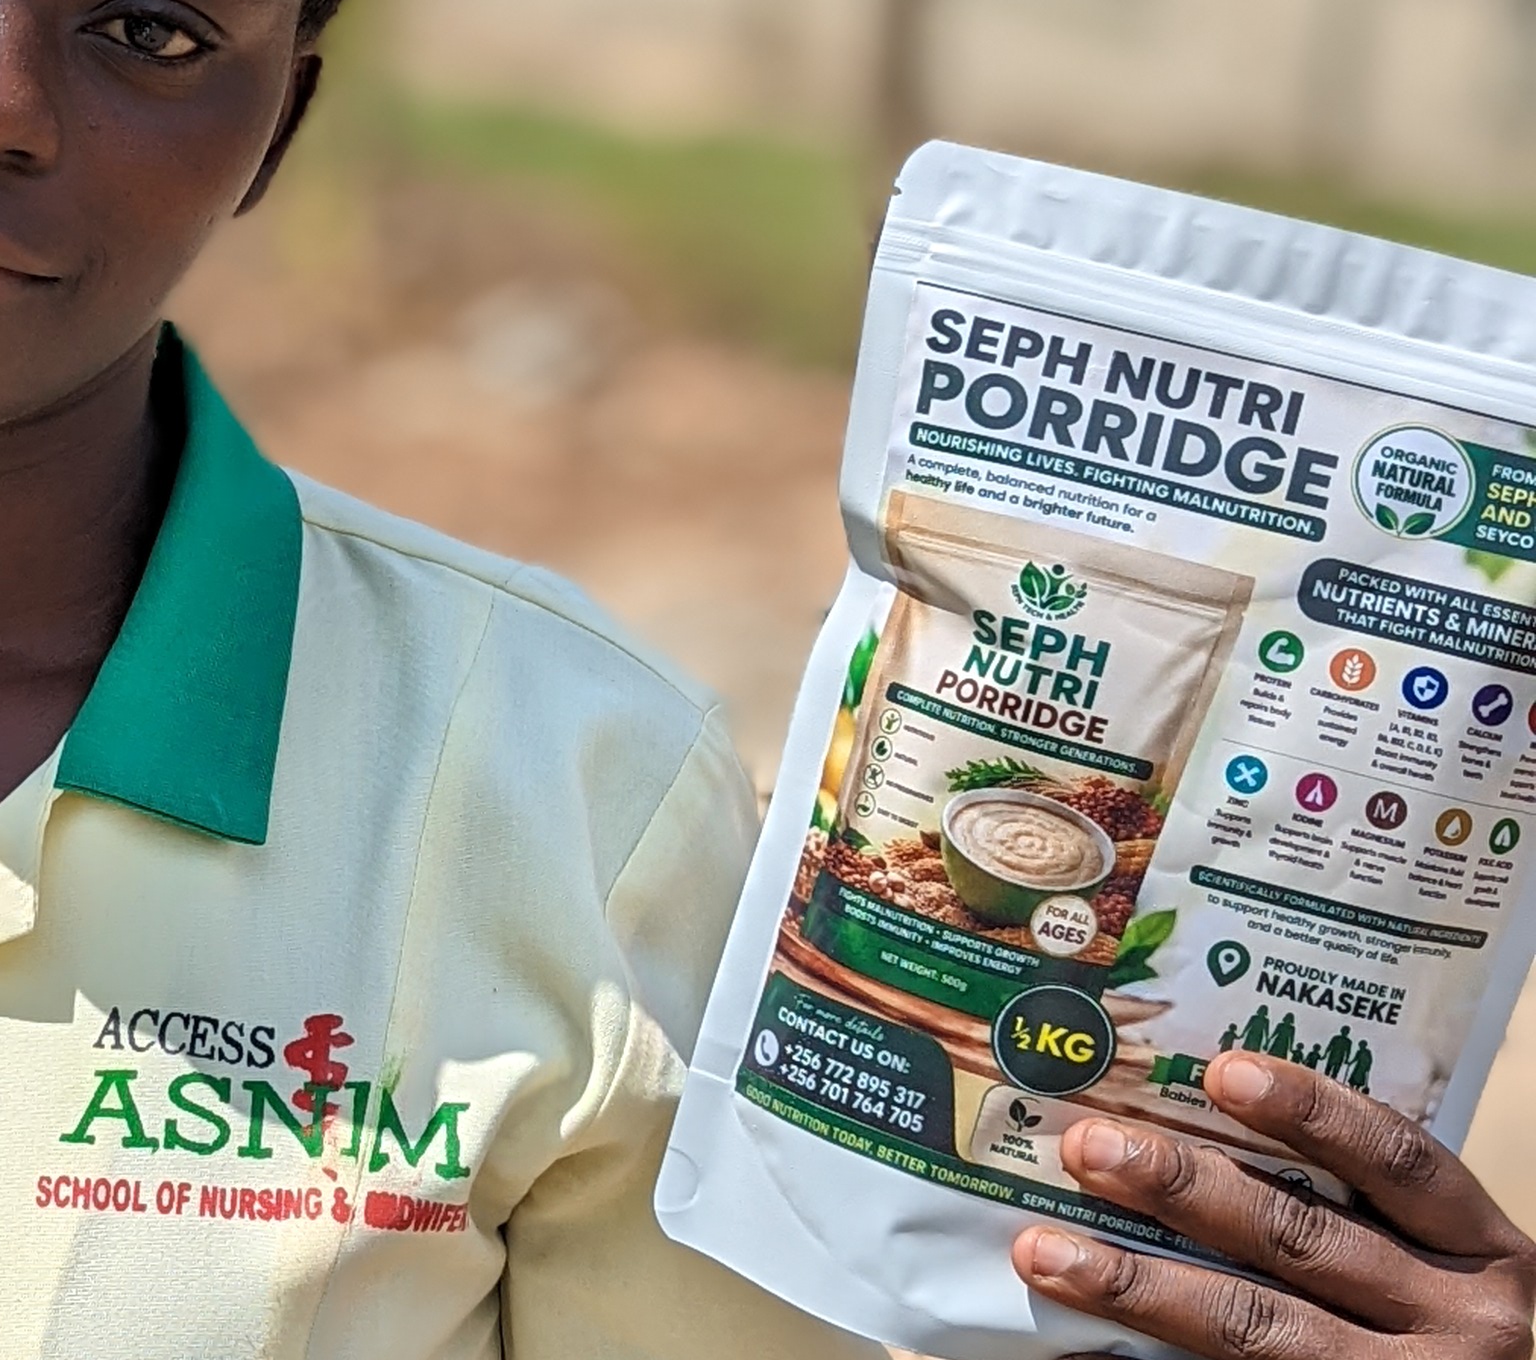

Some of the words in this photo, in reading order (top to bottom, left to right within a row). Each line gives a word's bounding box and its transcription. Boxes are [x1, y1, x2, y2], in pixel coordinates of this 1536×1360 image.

[925, 309, 1092, 386] SEPH
[1104, 350, 1305, 436] NUTRI
[915, 358, 1340, 511] PORRIDGE
[1380, 445, 1458, 476] ORGANIC
[905, 469, 952, 493] healthy
[954, 479, 976, 495] life
[978, 485, 1006, 502] and
[1009, 493, 1020, 505] a
[1022, 493, 1084, 522] brighter
[1086, 509, 1135, 534] future.
[907, 453, 917, 465] A
[918, 456, 983, 481] complete,
[985, 469, 1055, 497] balanced
[1058, 488, 1119, 513] nutrition
[1122, 502, 1143, 519] for
[1145, 511, 1157, 523] a
[916, 426, 1022, 463] NOURISHING
[1025, 451, 1079, 477] LIVES.
[1082, 465, 1170, 500] FIGHTING
[1172, 486, 1316, 537] MALNUTRITION.
[1371, 459, 1457, 499] NATURAL
[1375, 481, 1443, 513] FORMULA
[1475, 524, 1535, 550] SEYCO
[1480, 503, 1531, 530] AND
[1312, 579, 1440, 627] NUTRIENTS
[1444, 611, 1461, 632] &
[1465, 616, 1536, 652] MINER
[1339, 567, 1402, 595] PACKED
[1404, 583, 1447, 607] WITH
[1449, 595, 1479, 615] ALL
[972, 609, 1111, 677] SEPH
[1336, 607, 1376, 631] THAT
[1379, 618, 1427, 642] FIGHT
[962, 645, 1100, 710] NUTRI
[896, 690, 942, 719] COMPLETE
[942, 702, 997, 737] NUTRITION.
[1000, 727, 1058, 754] STRONGER
[1059, 742, 1139, 775] GENERATIONS.
[935, 669, 1109, 745] PORRIDGE
[838, 887, 866, 908] FIGHTS
[867, 896, 935, 935] MALNUTRITION
[942, 928, 993, 956] SUPPORTS
[994, 944, 1041, 968] GROWTH
[844, 903, 877, 927] BOOSTS
[877, 915, 924, 945] IMMUNITY
[931, 938, 981, 967] IMPROVES
[982, 954, 1023, 976] ENERGY
[1037, 920, 1088, 946] AGES
[1045, 904, 1068, 920] FOR
[1069, 909, 1090, 926] ALL
[880, 950, 897, 965] NET
[898, 956, 940, 982] WEIGHT:
[941, 972, 968, 993] 500g
[1255, 972, 1402, 1025] NAKASEKE
[1263, 955, 1340, 986] PROUDLY
[1340, 973, 1389, 996] MADE
[1390, 985, 1407, 1002] IN
[93, 1006, 275, 1070] ACCESS
[777, 1006, 848, 1052] CONTACT
[849, 1035, 875, 1061] US
[877, 1048, 912, 1075] ON:
[1036, 1022, 1096, 1064] KG
[779, 1062, 817, 1091] +256
[820, 1078, 850, 1106] 701
[852, 1094, 884, 1119] 764
[887, 1107, 924, 1133] 705
[784, 1042, 822, 1071] +256
[826, 1054, 854, 1080] 772
[857, 1069, 892, 1097] 895
[895, 1084, 927, 1109] 317
[1159, 1086, 1207, 1109] Babies
[745, 1084, 772, 1108] GOOD
[771, 1100, 830, 1137] NUTRITION
[831, 1126, 875, 1155] TODAY.
[876, 1145, 928, 1175] BETTER
[929, 1164, 1015, 1202] TOMORROW.
[1021, 1191, 1056, 1213] SEPH
[1057, 1202, 1098, 1224] NUTRI
[1098, 1214, 1164, 1242] PORRIDGE
[989, 1143, 1041, 1167] NATURAL
[1001, 1131, 1034, 1151] 100%
[35, 1175, 147, 1213] SCHOOL
[155, 1180, 192, 1216] OF
[199, 1185, 323, 1222] NURSING
[330, 1186, 354, 1224] &
